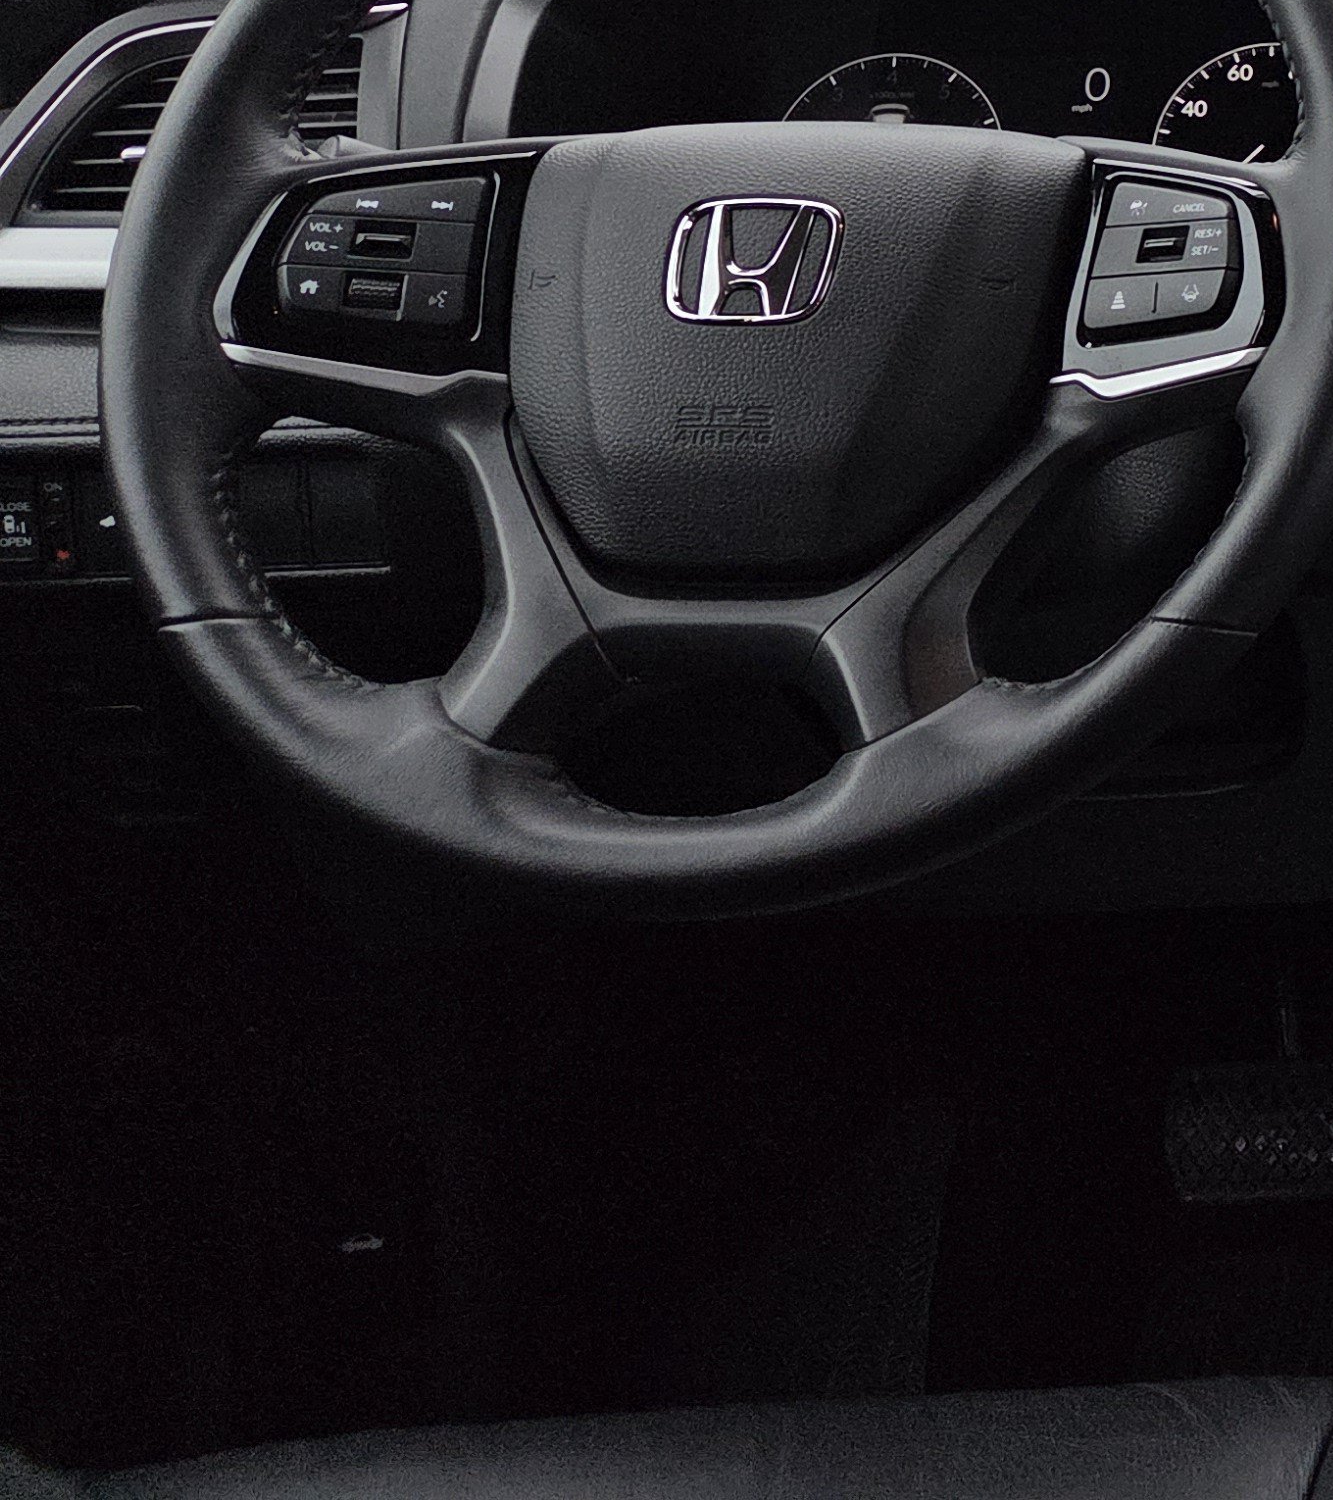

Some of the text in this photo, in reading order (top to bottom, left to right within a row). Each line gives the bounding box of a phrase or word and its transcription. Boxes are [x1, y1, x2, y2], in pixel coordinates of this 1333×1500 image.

[1226, 63, 1254, 82] 60
[1084, 66, 1111, 102] 0
[1180, 99, 1208, 118] 40
[1172, 203, 1205, 213] CANCEL
